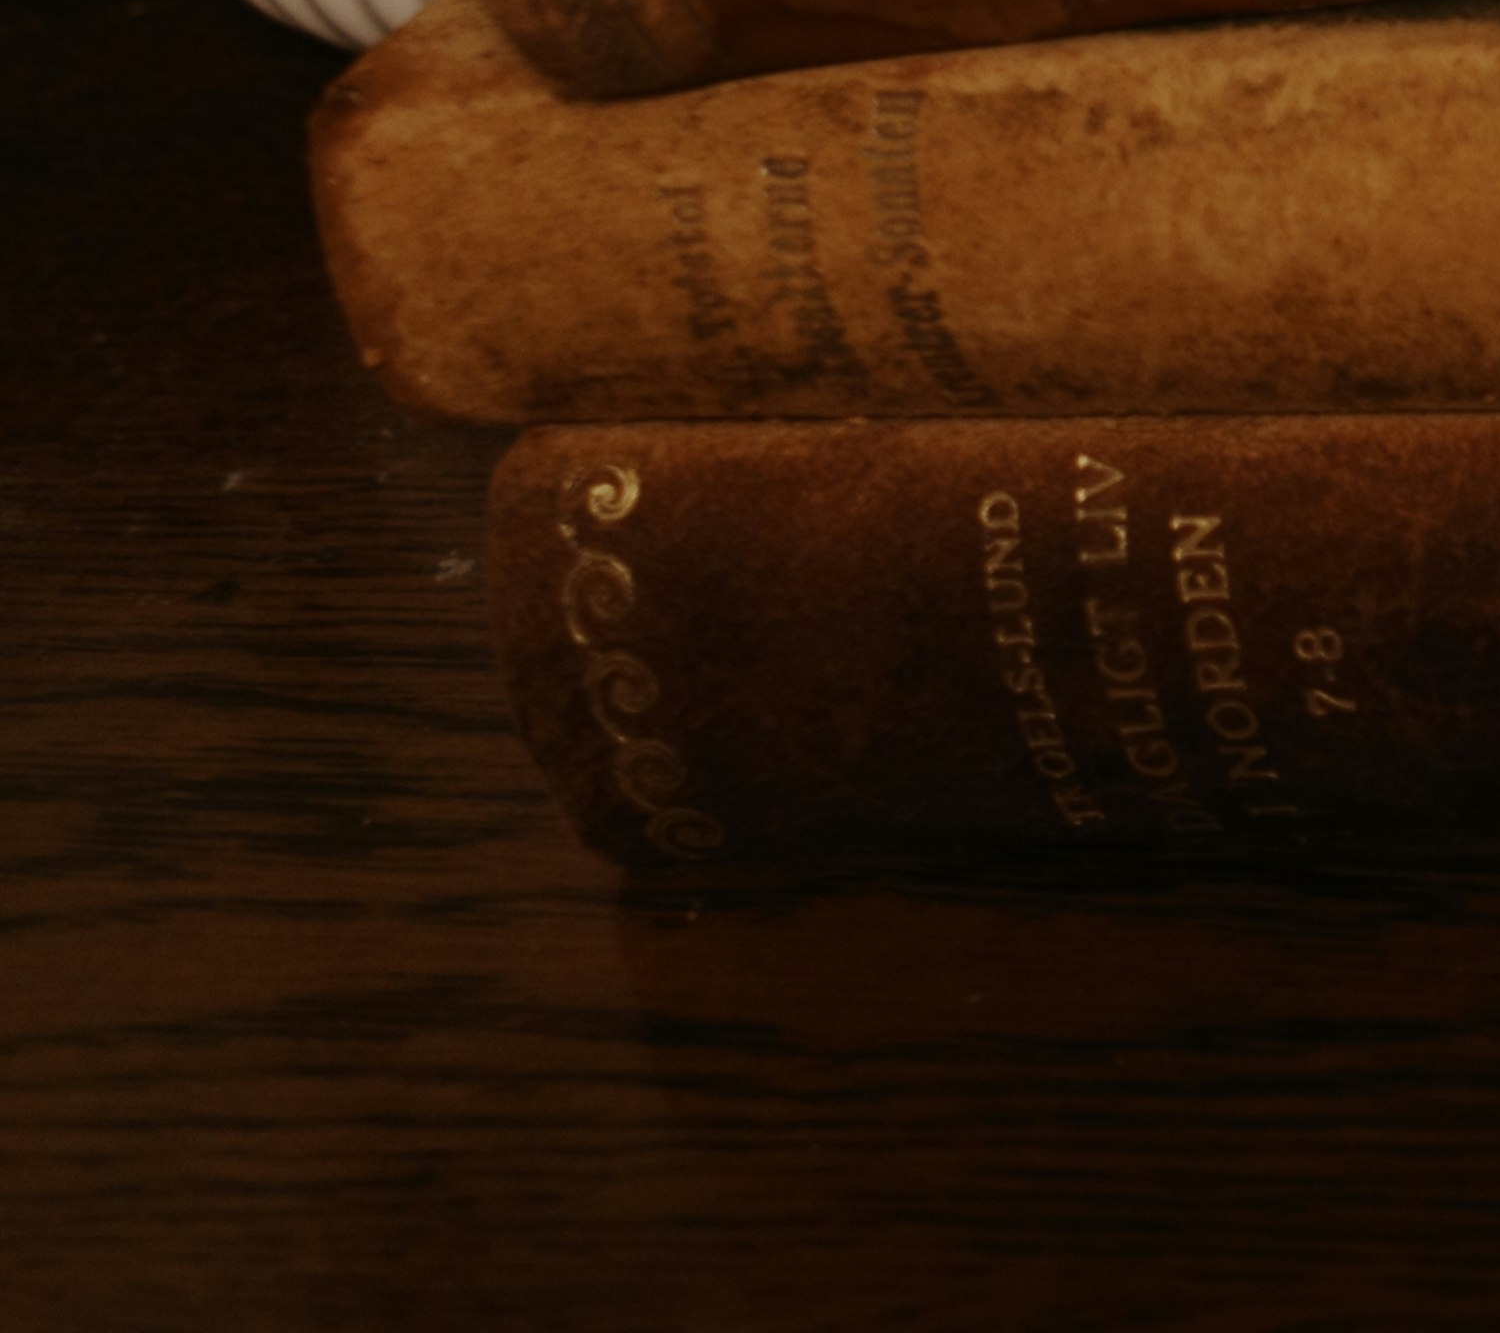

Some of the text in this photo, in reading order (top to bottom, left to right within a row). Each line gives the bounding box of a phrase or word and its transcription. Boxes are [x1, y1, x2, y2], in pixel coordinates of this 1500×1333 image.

[976, 489, 1106, 827] TROELS-LUND
[1072, 452, 1222, 833] DAGLIGT LIV
[1167, 511, 1280, 782] NORDEN
[1291, 624, 1360, 720] 7-8
